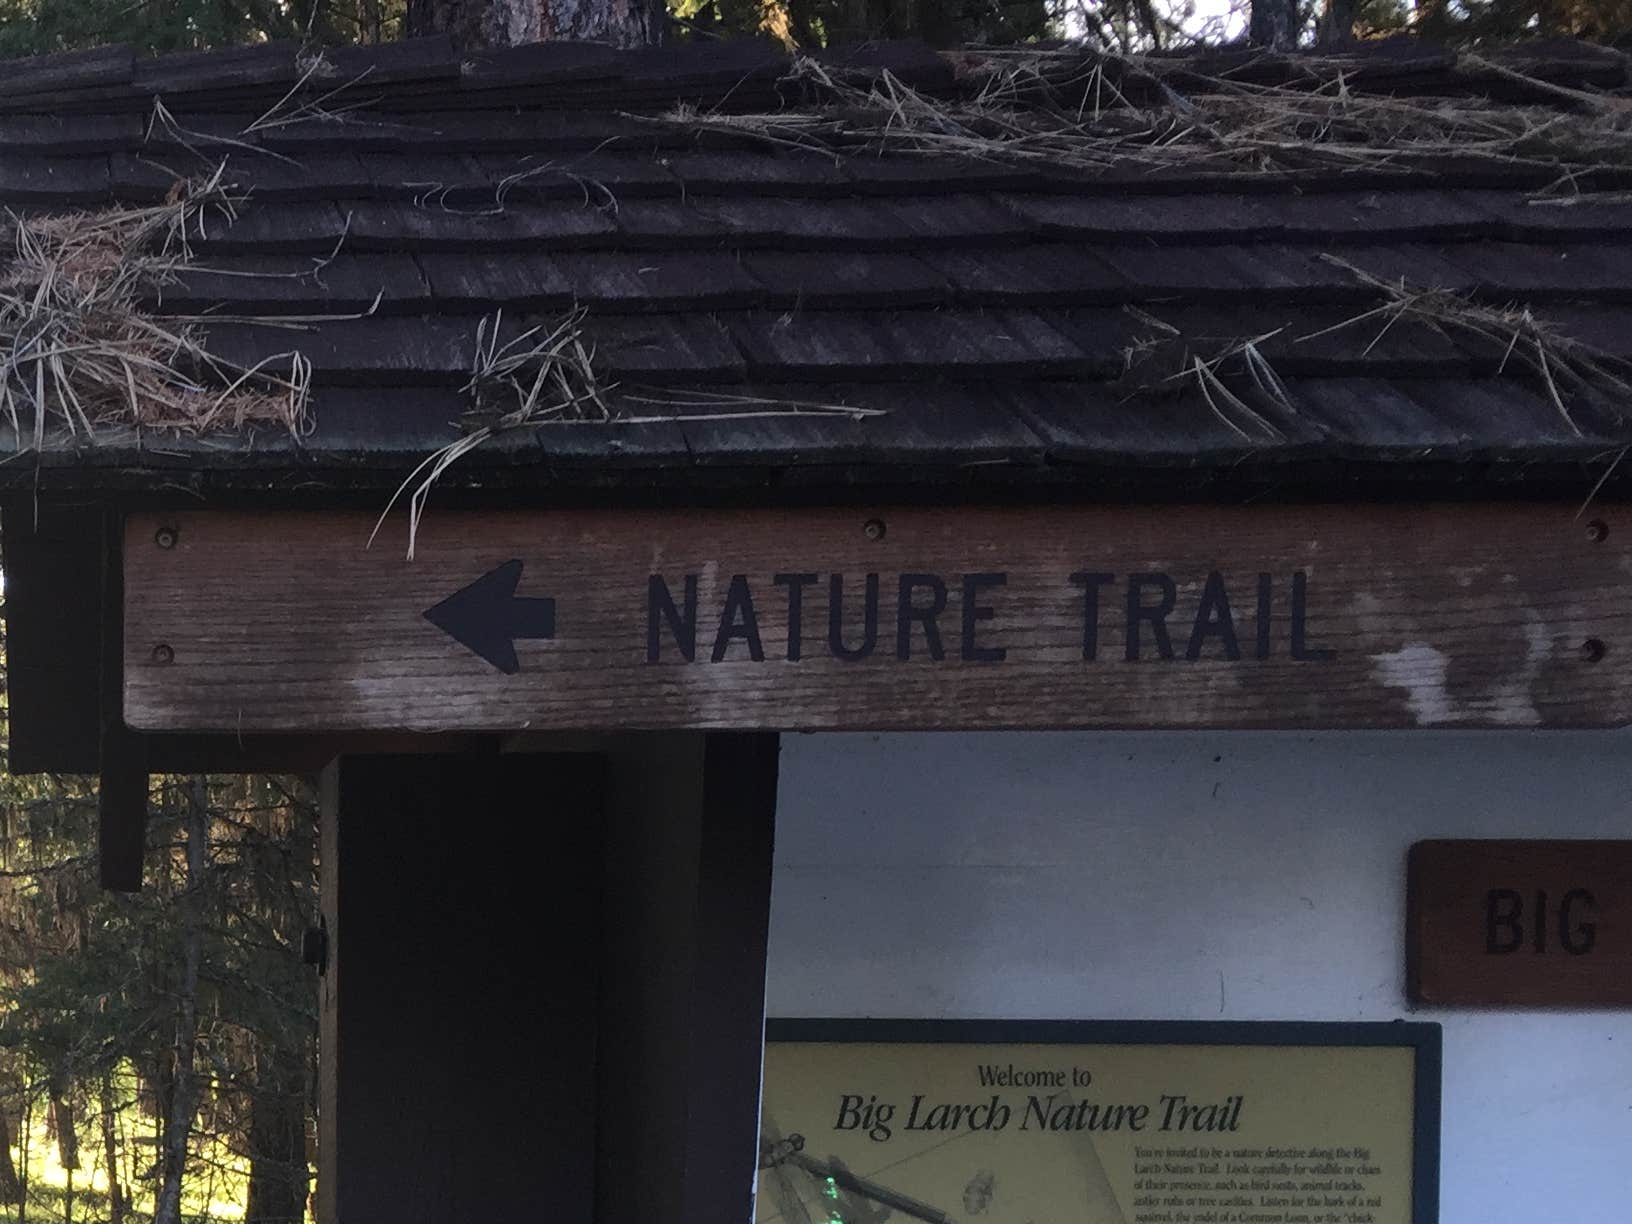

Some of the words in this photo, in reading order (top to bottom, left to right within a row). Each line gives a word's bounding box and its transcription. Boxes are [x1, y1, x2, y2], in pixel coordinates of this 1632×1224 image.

[647, 572, 1008, 663] NATURE
[1070, 572, 1338, 663] TRAIL
[1485, 887, 1599, 955] BIG
[977, 1065, 1067, 1087] Welcome
[1072, 1065, 1092, 1087] to
[833, 1095, 896, 1142] Big
[904, 1094, 1010, 1132] Larch
[1022, 1094, 1150, 1132] Nature
[1158, 1094, 1244, 1132] Trail
